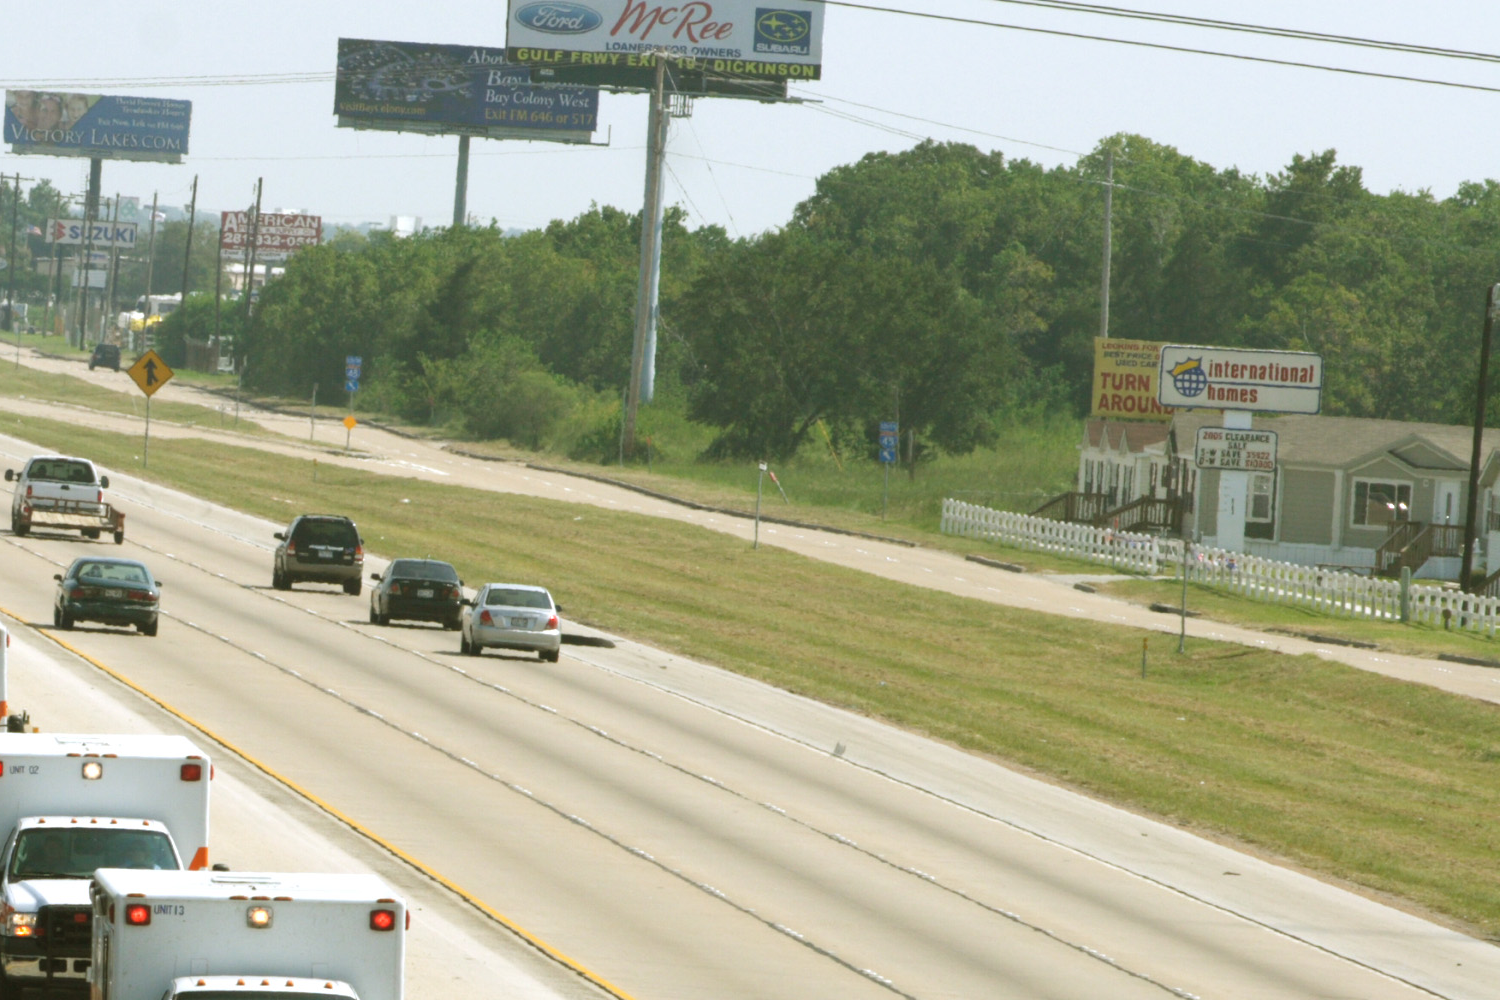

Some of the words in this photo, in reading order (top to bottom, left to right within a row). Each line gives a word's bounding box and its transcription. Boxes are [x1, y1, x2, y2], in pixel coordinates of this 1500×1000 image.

[533, 5, 584, 29] Ford
[610, 0, 733, 43] McRee
[691, 47, 741, 58] OWNERS
[756, 43, 808, 54] SUBARU
[517, 48, 563, 62] GULF
[571, 51, 620, 66] FRWY
[628, 53, 665, 67] EXI
[714, 60, 815, 77] DICKINSON
[486, 69, 522, 91] Bay
[485, 88, 510, 106] Bay
[513, 91, 555, 109] Colony
[559, 93, 590, 108] West
[485, 108, 506, 120] Exit
[510, 109, 528, 121] FM
[556, 114, 569, 124] or
[572, 113, 594, 126] 517
[11, 124, 85, 143] VICTORY
[223, 212, 318, 232] AMERICAN
[69, 225, 134, 243] SUZUKI
[1208, 359, 1315, 383] international
[1101, 372, 1150, 393] TURN
[1207, 383, 1258, 403] homes
[1225, 433, 1270, 443] CLEARANCE
[9, 765, 24, 774] UNIT
[29, 765, 39, 775] 02
[153, 904, 172, 915] UNIT
[174, 905, 185, 916] 13
